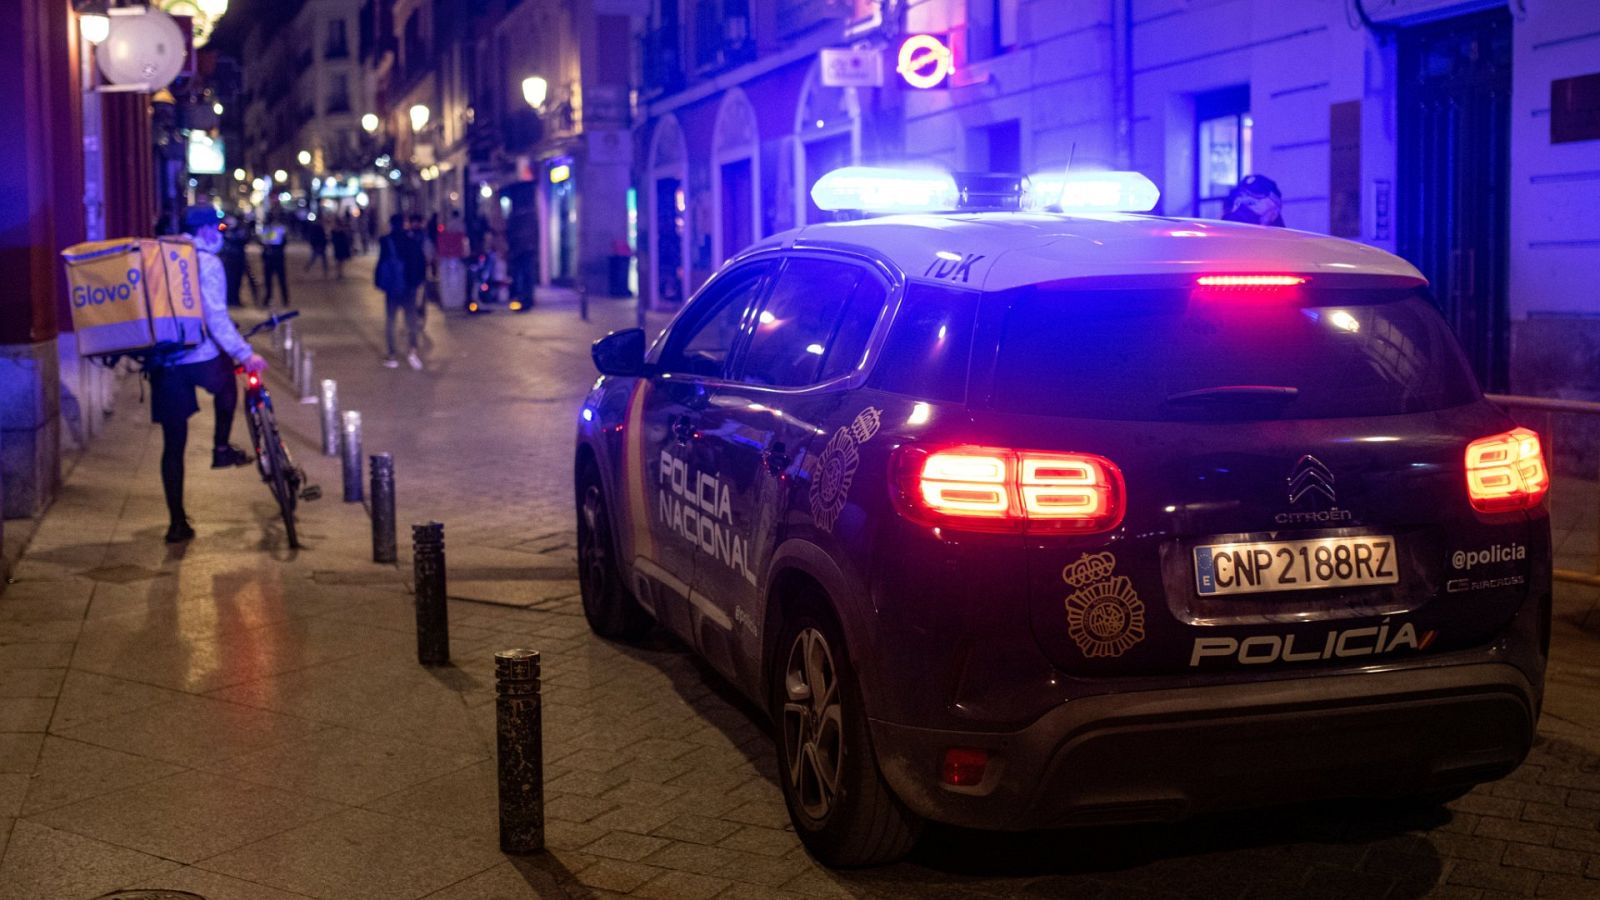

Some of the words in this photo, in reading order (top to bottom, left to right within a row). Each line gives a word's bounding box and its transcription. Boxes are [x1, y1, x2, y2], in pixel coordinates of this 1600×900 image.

[73, 283, 131, 308] Glovo
[178, 259, 195, 310] Glovo
[659, 450, 732, 526] POLICÍA
[659, 491, 757, 586] NACIONAL
[1452, 542, 1526, 570] @policia
[1203, 575, 1210, 586] E
[1213, 542, 1394, 588] CNP2188RZ
[1189, 618, 1419, 667] POLICÍA
